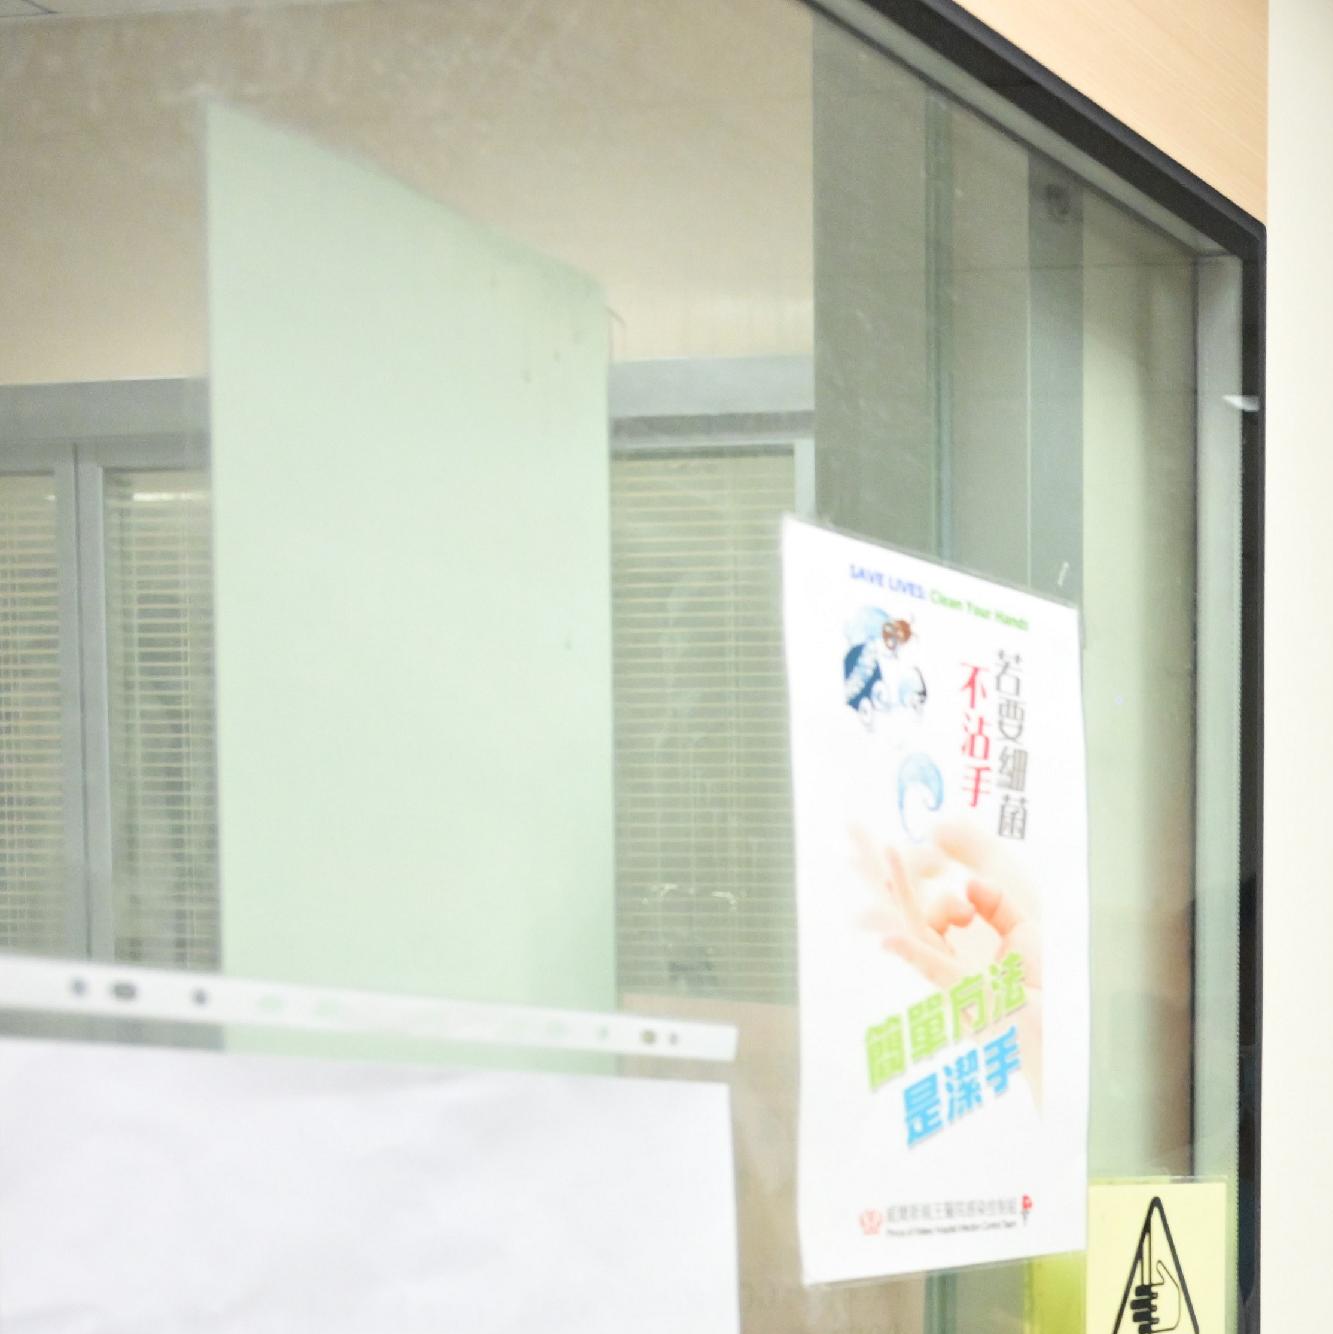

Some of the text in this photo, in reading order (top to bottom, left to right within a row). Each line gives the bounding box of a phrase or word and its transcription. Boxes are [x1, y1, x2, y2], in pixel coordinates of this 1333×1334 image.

[960, 662, 992, 808] 不沾手
[864, 952, 1027, 1093] 簡單方法
[903, 1026, 1021, 1149] 是潔手
